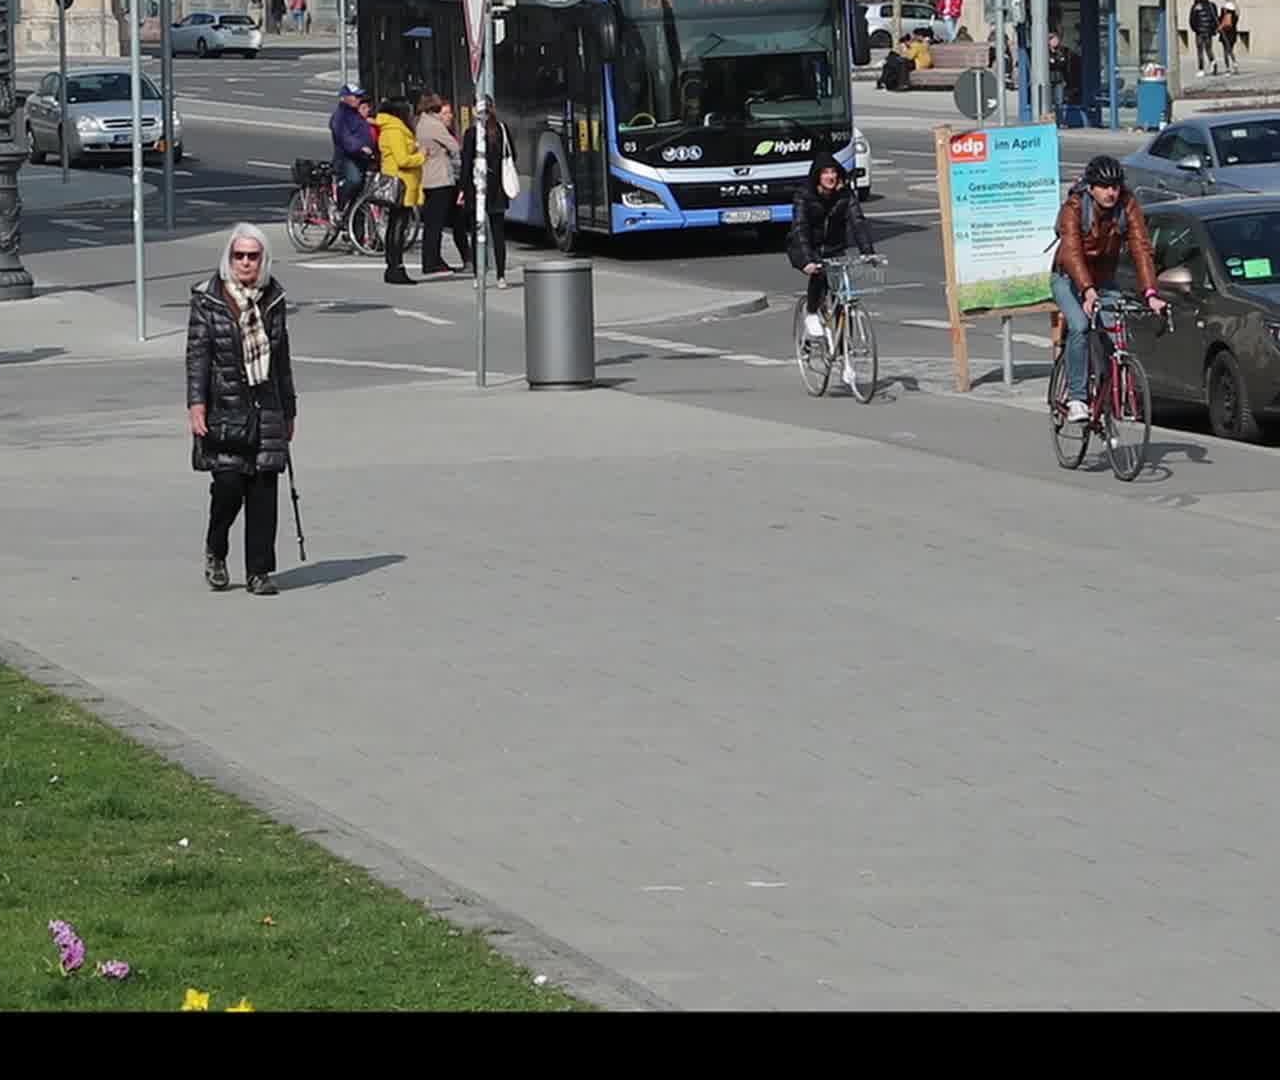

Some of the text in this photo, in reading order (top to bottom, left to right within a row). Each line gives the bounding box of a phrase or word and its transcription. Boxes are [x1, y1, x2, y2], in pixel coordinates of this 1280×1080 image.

[774, 138, 812, 155] Hybrid
[1012, 137, 1041, 151] April
[720, 184, 768, 197] MAN
